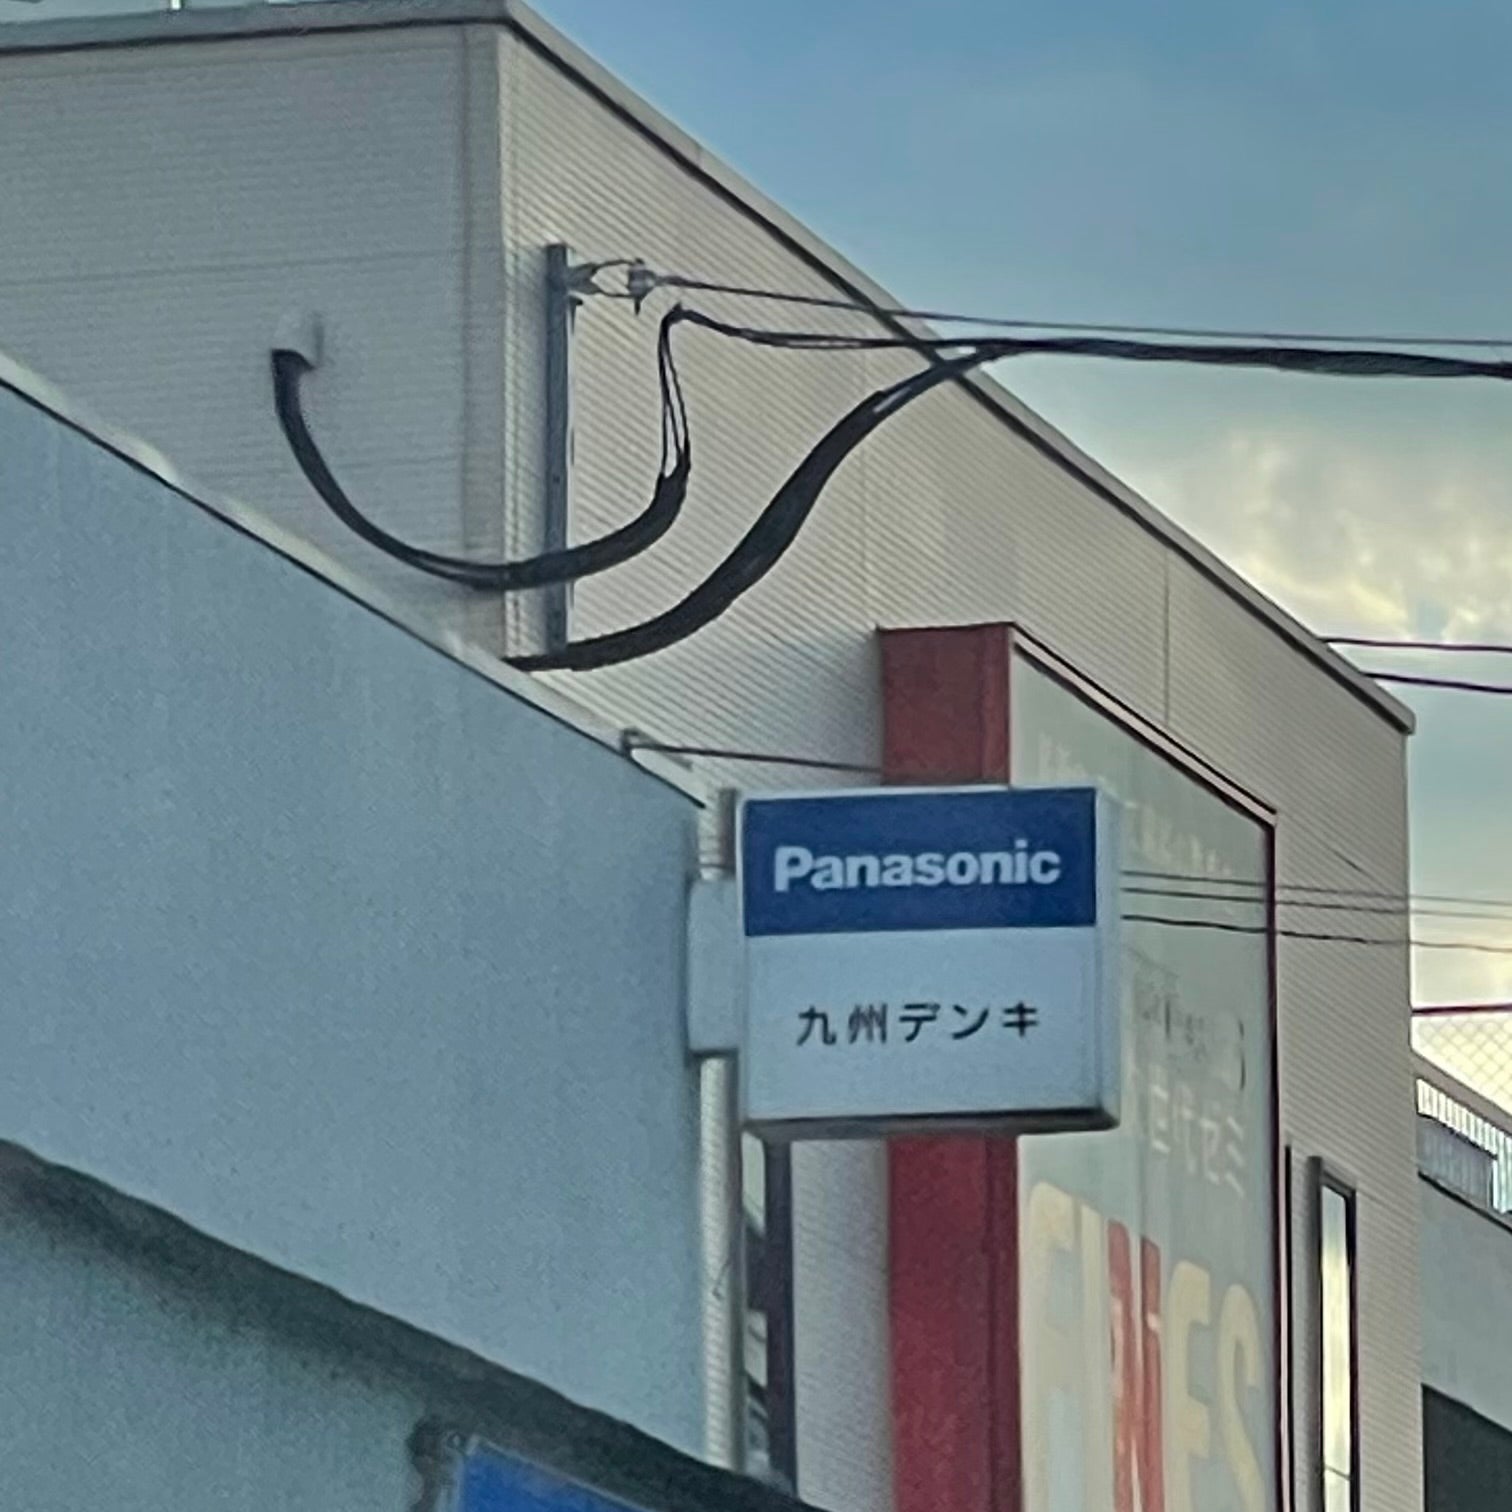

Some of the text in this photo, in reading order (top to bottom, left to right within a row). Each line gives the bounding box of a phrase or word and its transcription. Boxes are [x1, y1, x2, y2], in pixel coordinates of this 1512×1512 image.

[773, 838, 1062, 893] Panasonic
[796, 1001, 1041, 1047] 九州デンキ
